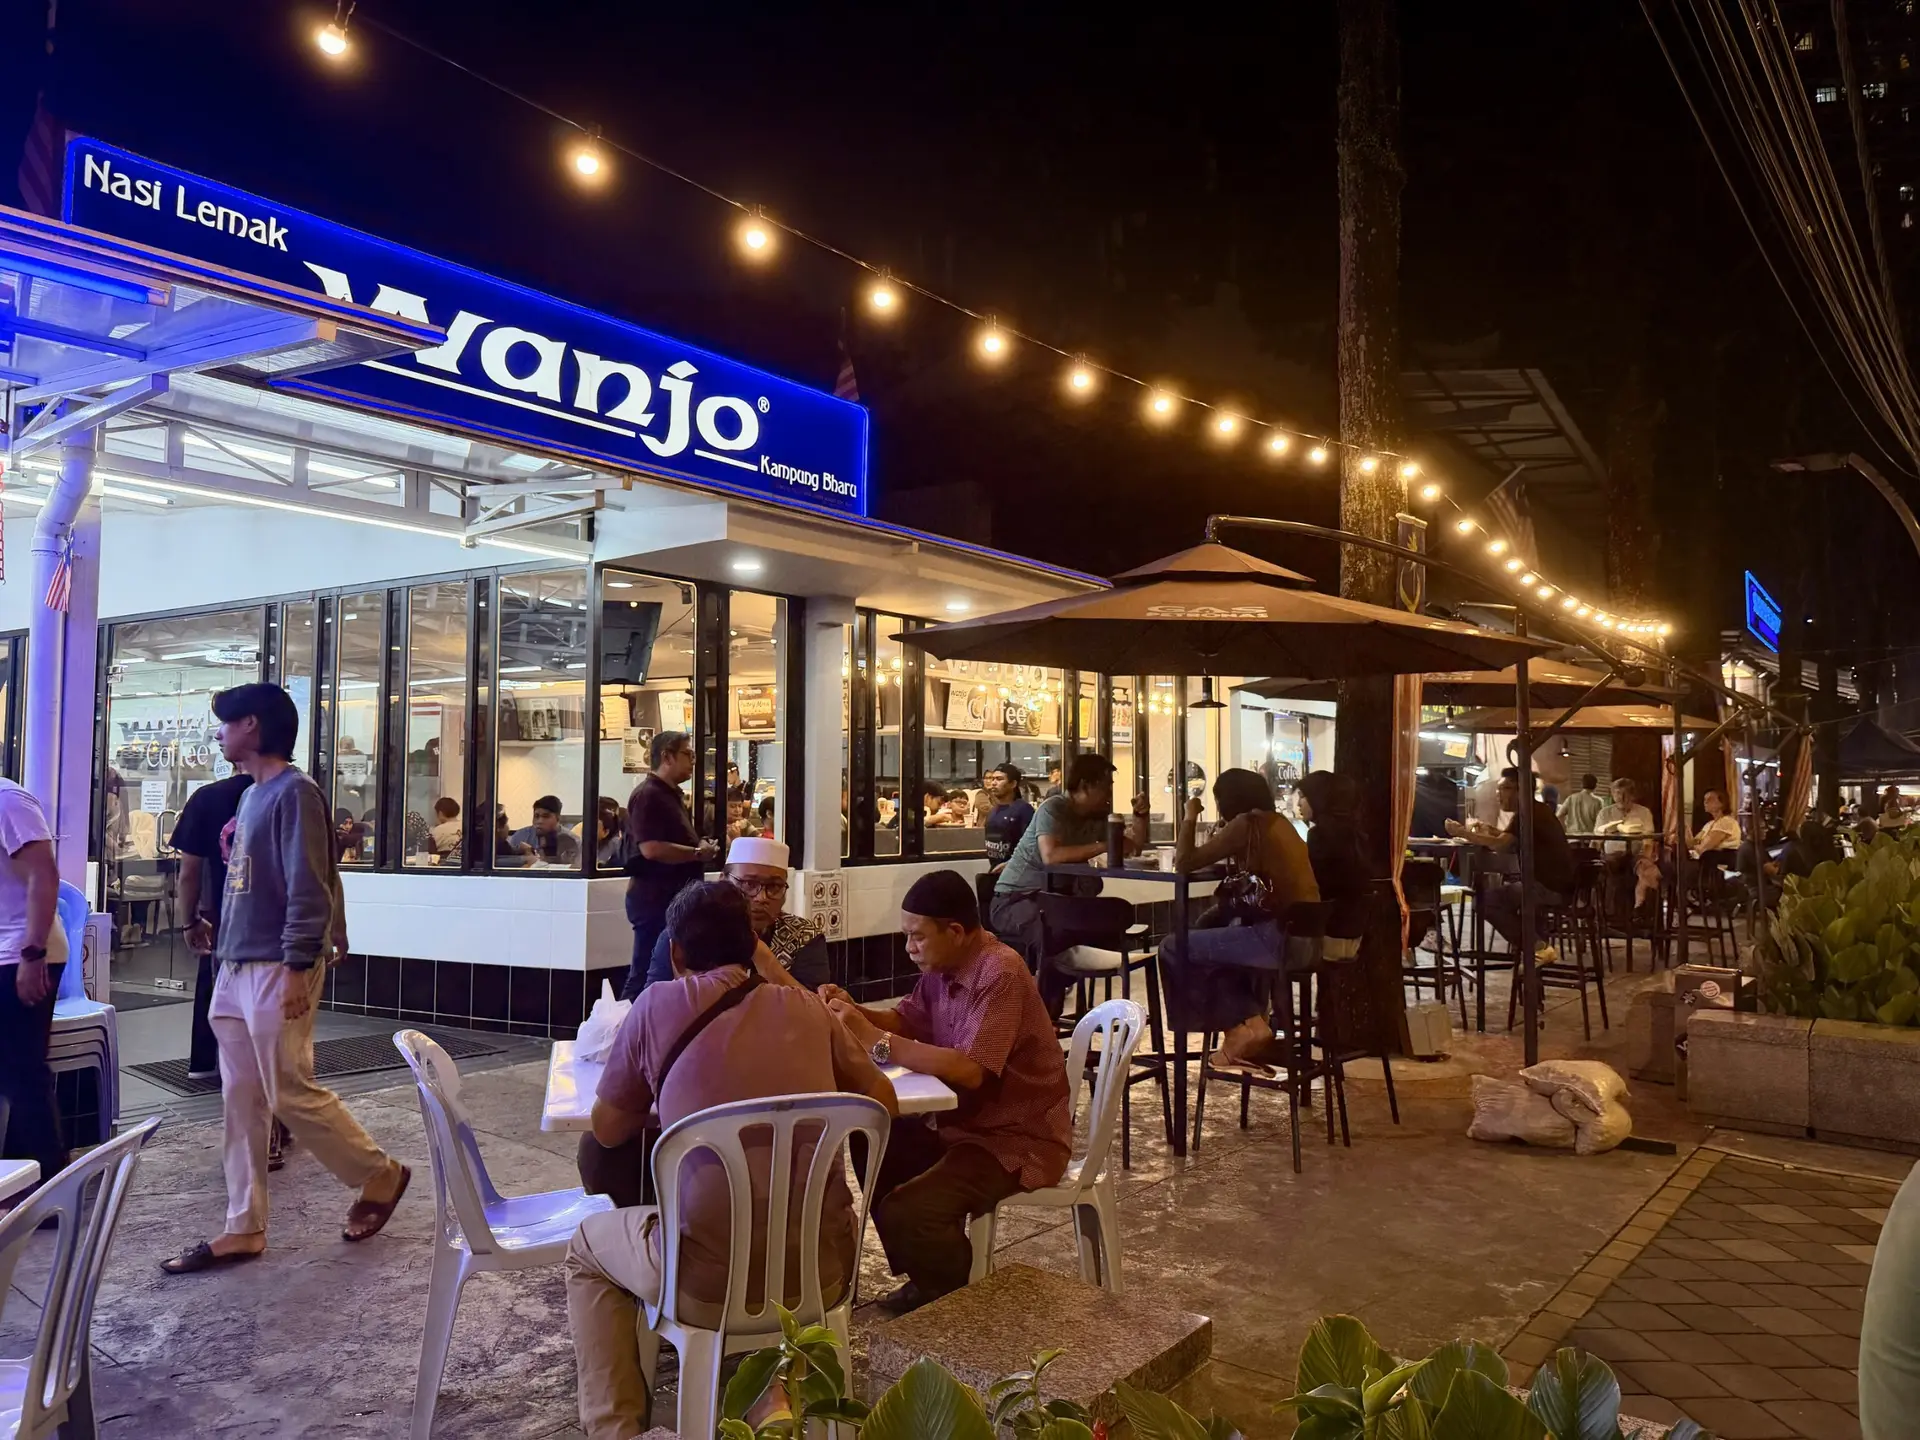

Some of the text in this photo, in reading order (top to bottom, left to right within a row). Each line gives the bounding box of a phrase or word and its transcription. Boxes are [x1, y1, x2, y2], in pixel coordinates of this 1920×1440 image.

[83, 153, 289, 252] Nasi Lemak
[760, 454, 857, 498] Kampung Bharu
